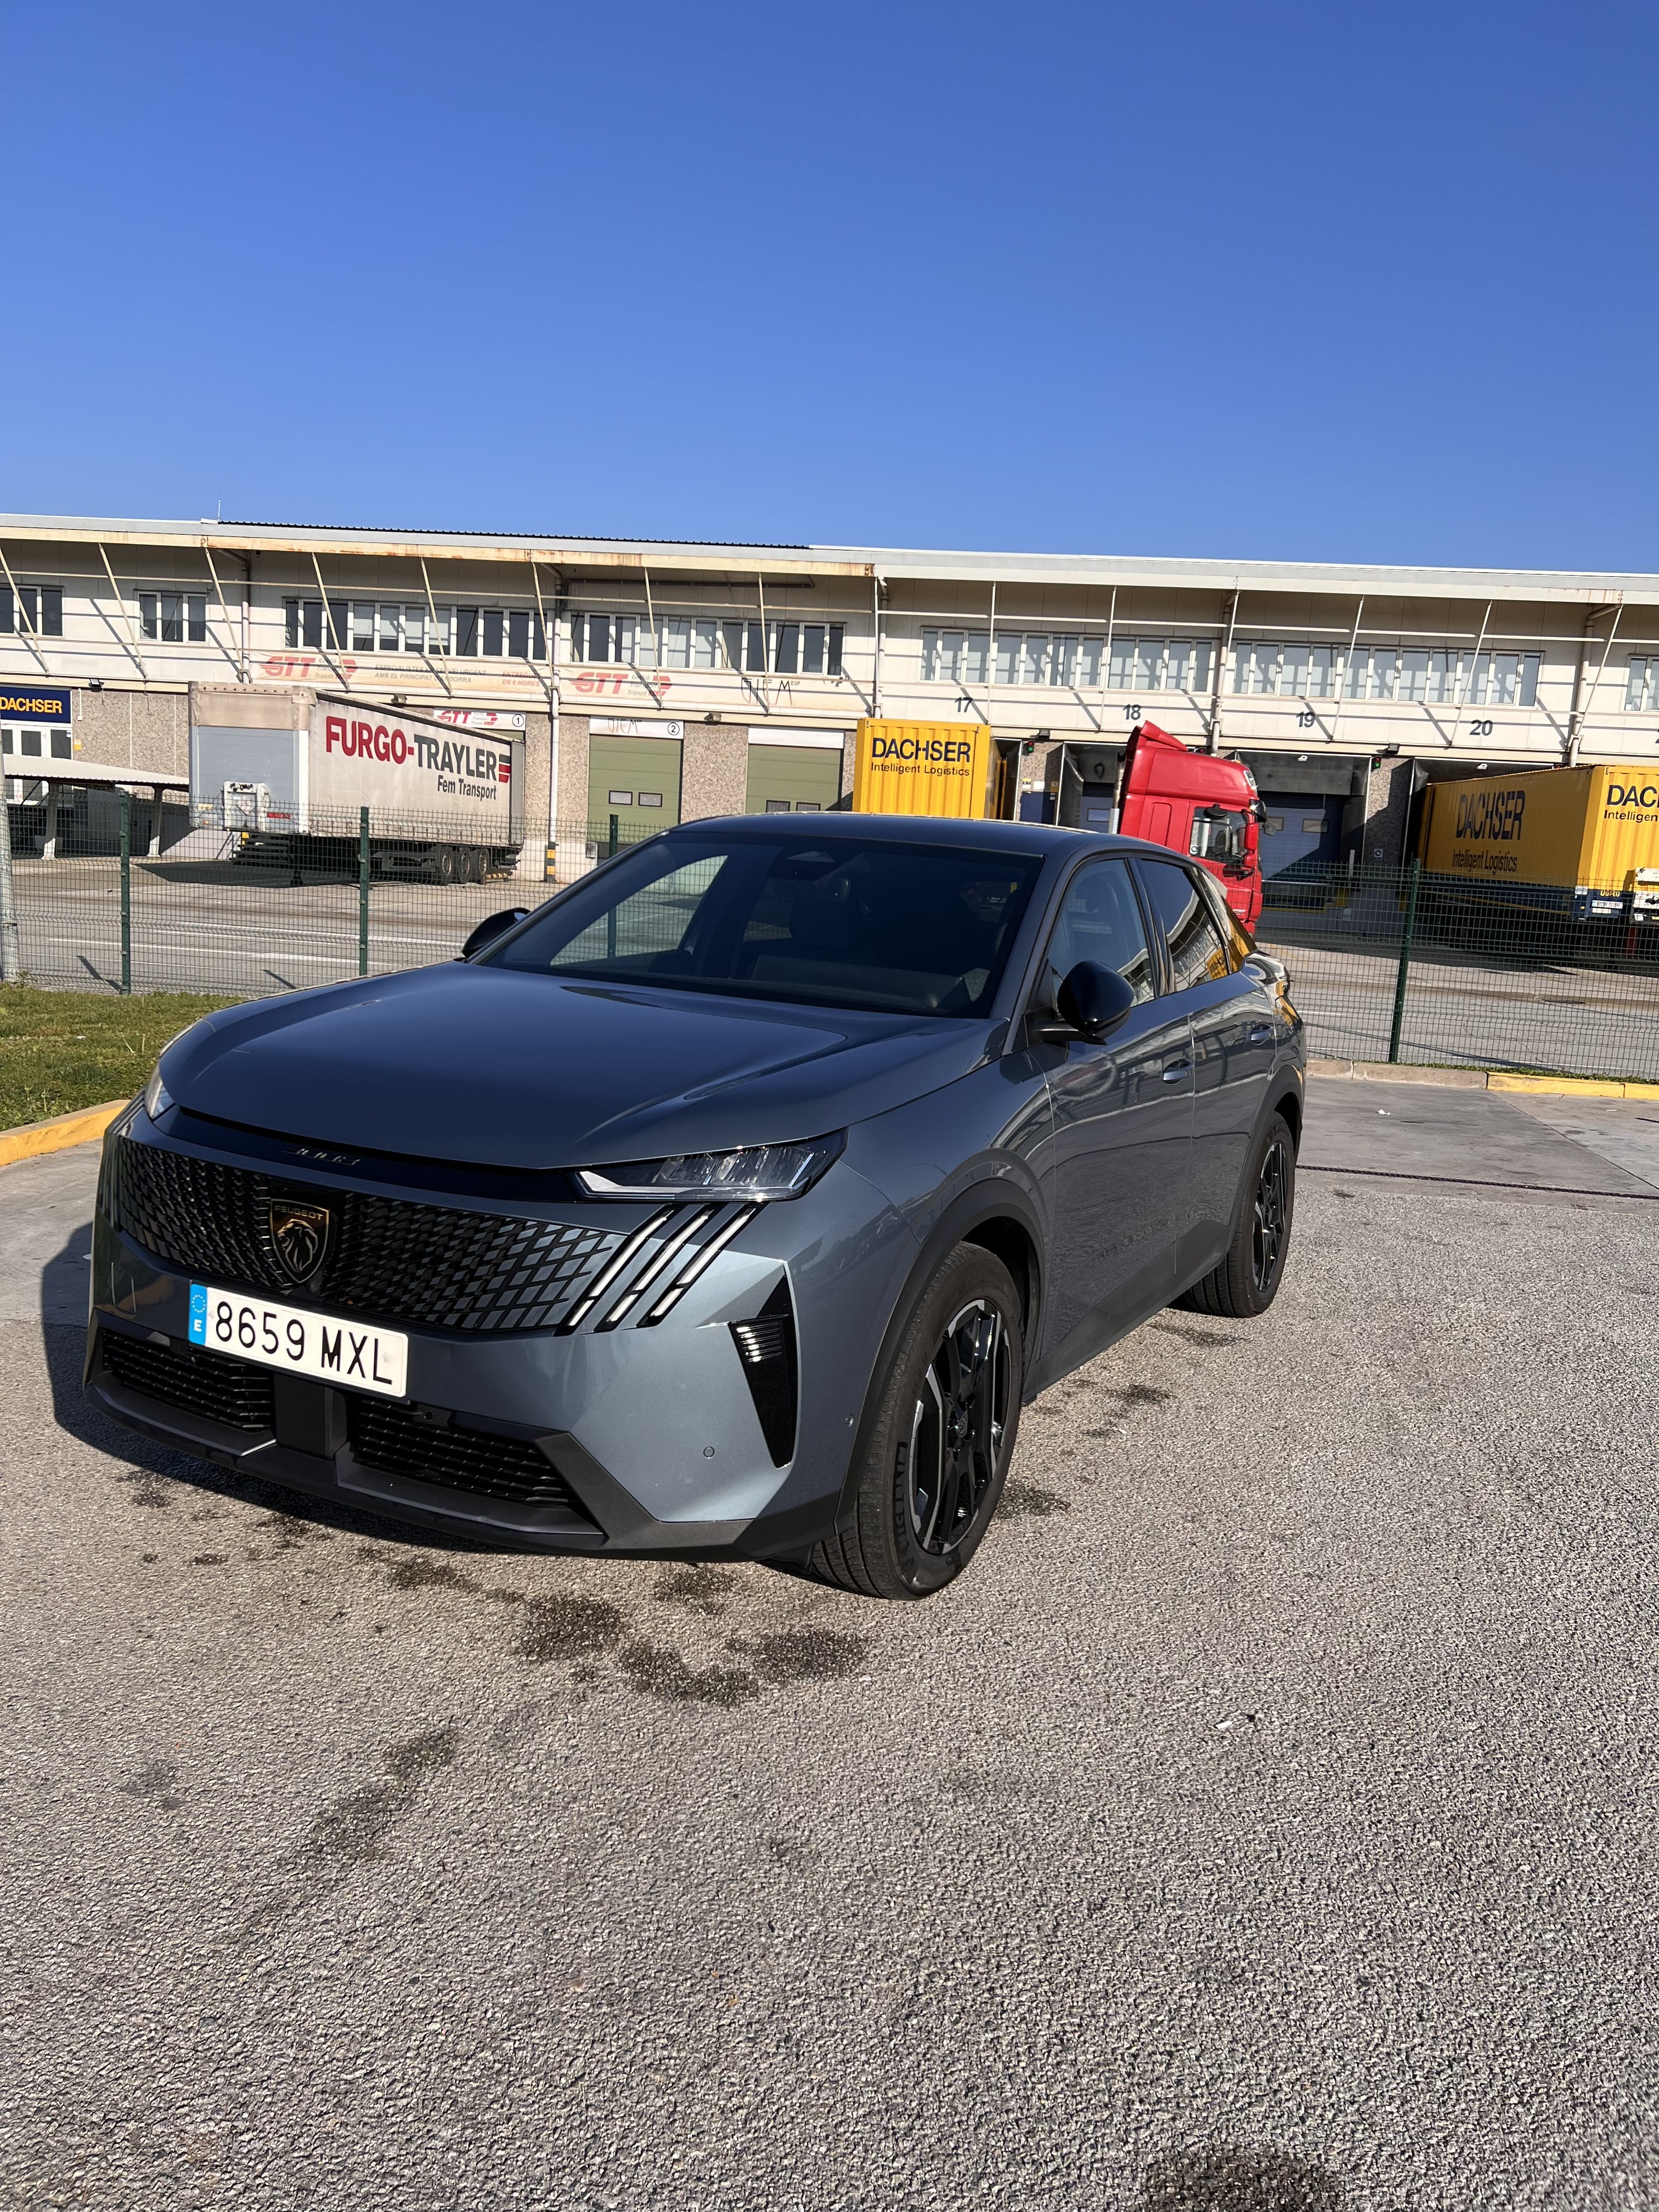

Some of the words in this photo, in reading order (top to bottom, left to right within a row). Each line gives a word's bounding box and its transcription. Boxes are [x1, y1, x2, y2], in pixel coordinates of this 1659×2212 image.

[0, 697, 62, 714] DACHSER
[955, 697, 973, 712] 17
[1123, 704, 1141, 720] 18
[1296, 711, 1316, 727] 19
[1469, 719, 1493, 736] 20
[326, 716, 497, 781] FURGO-TRAYLER
[872, 737, 971, 763] DACHSER
[871, 762, 920, 774] Intelligent
[924, 765, 970, 776] Logistics
[437, 775, 456, 794] Fem
[458, 778, 496, 802] Transport
[1607, 785, 1659, 808] DAC
[1455, 790, 1526, 840] DACHSER
[1452, 849, 1484, 872] Intelligent
[1485, 850, 1517, 876] Logistics
[275, 1205, 324, 1221] PEUGEOT
[193, 1319, 202, 1333] E
[216, 1301, 305, 1361] 8659
[321, 1325, 393, 1385] MXL
